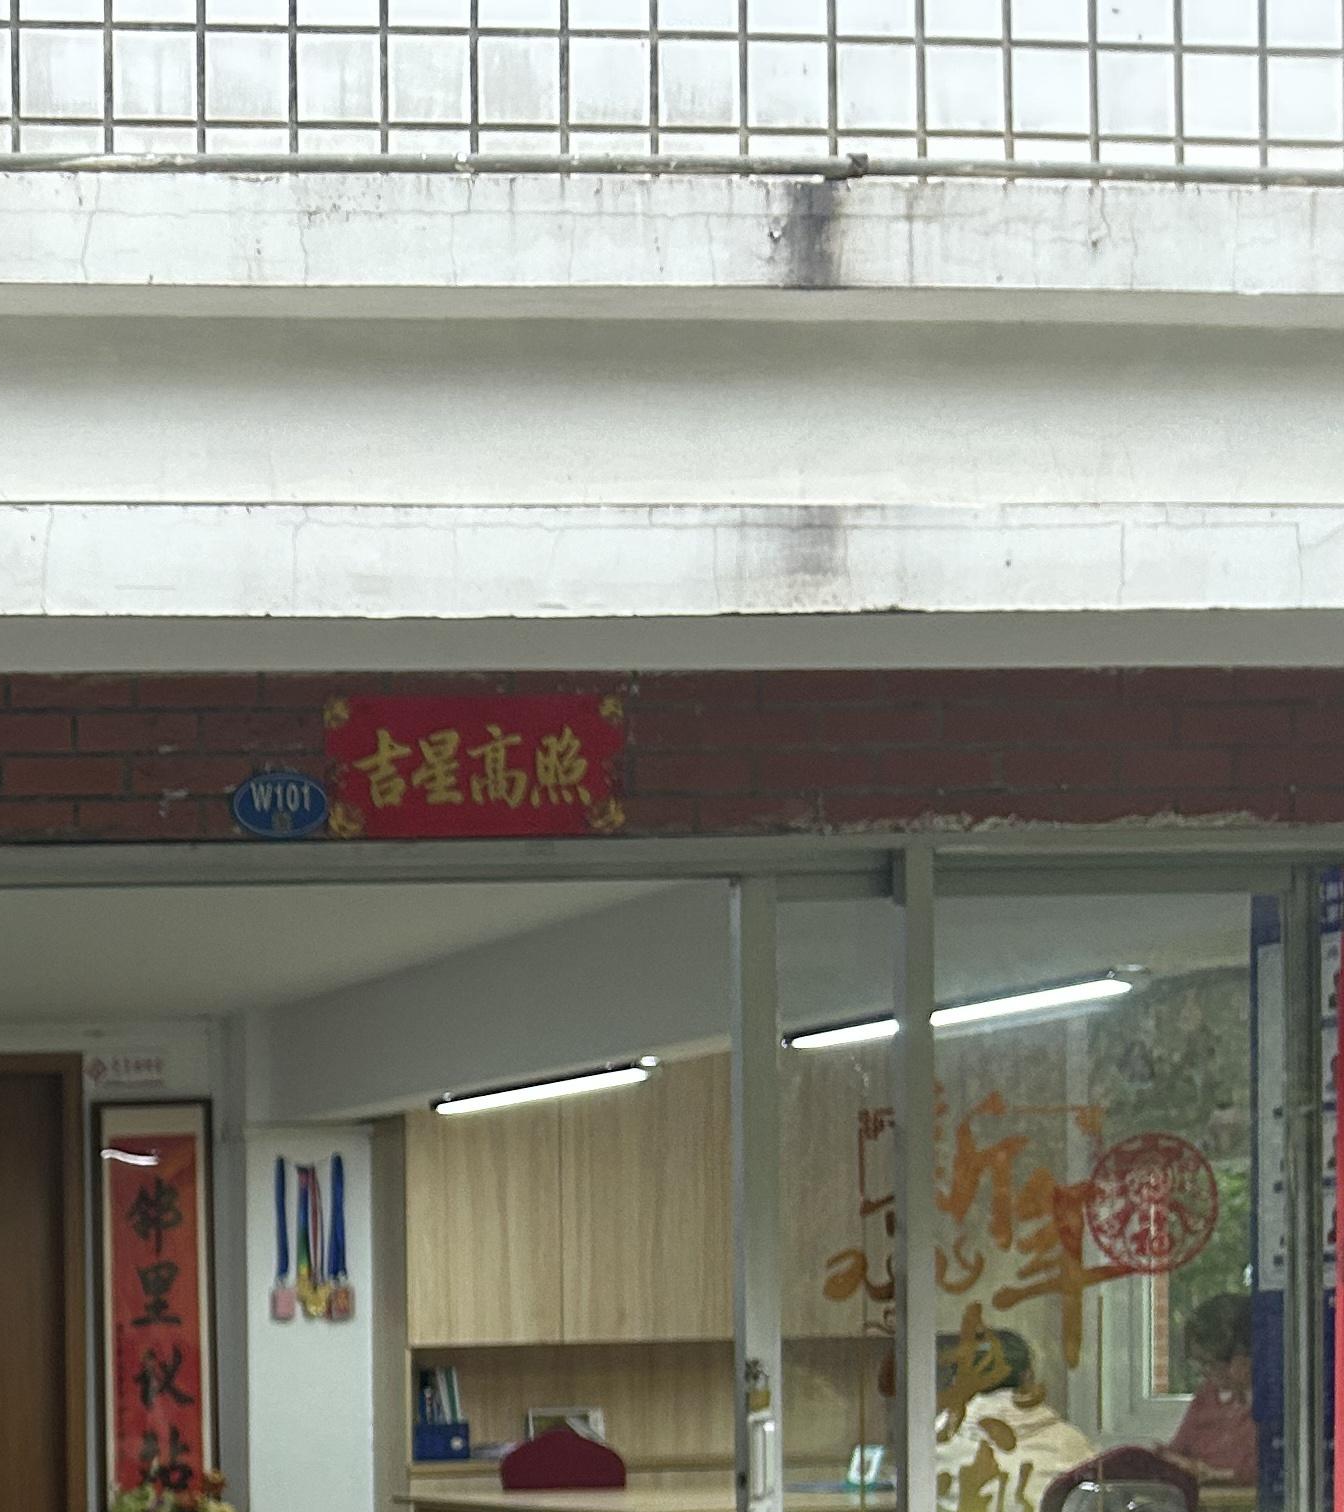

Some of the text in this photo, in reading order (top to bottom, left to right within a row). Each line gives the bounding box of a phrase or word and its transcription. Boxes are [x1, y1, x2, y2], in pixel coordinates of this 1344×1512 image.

[352, 723, 592, 809] 吉星高照
[250, 780, 312, 812] W101
